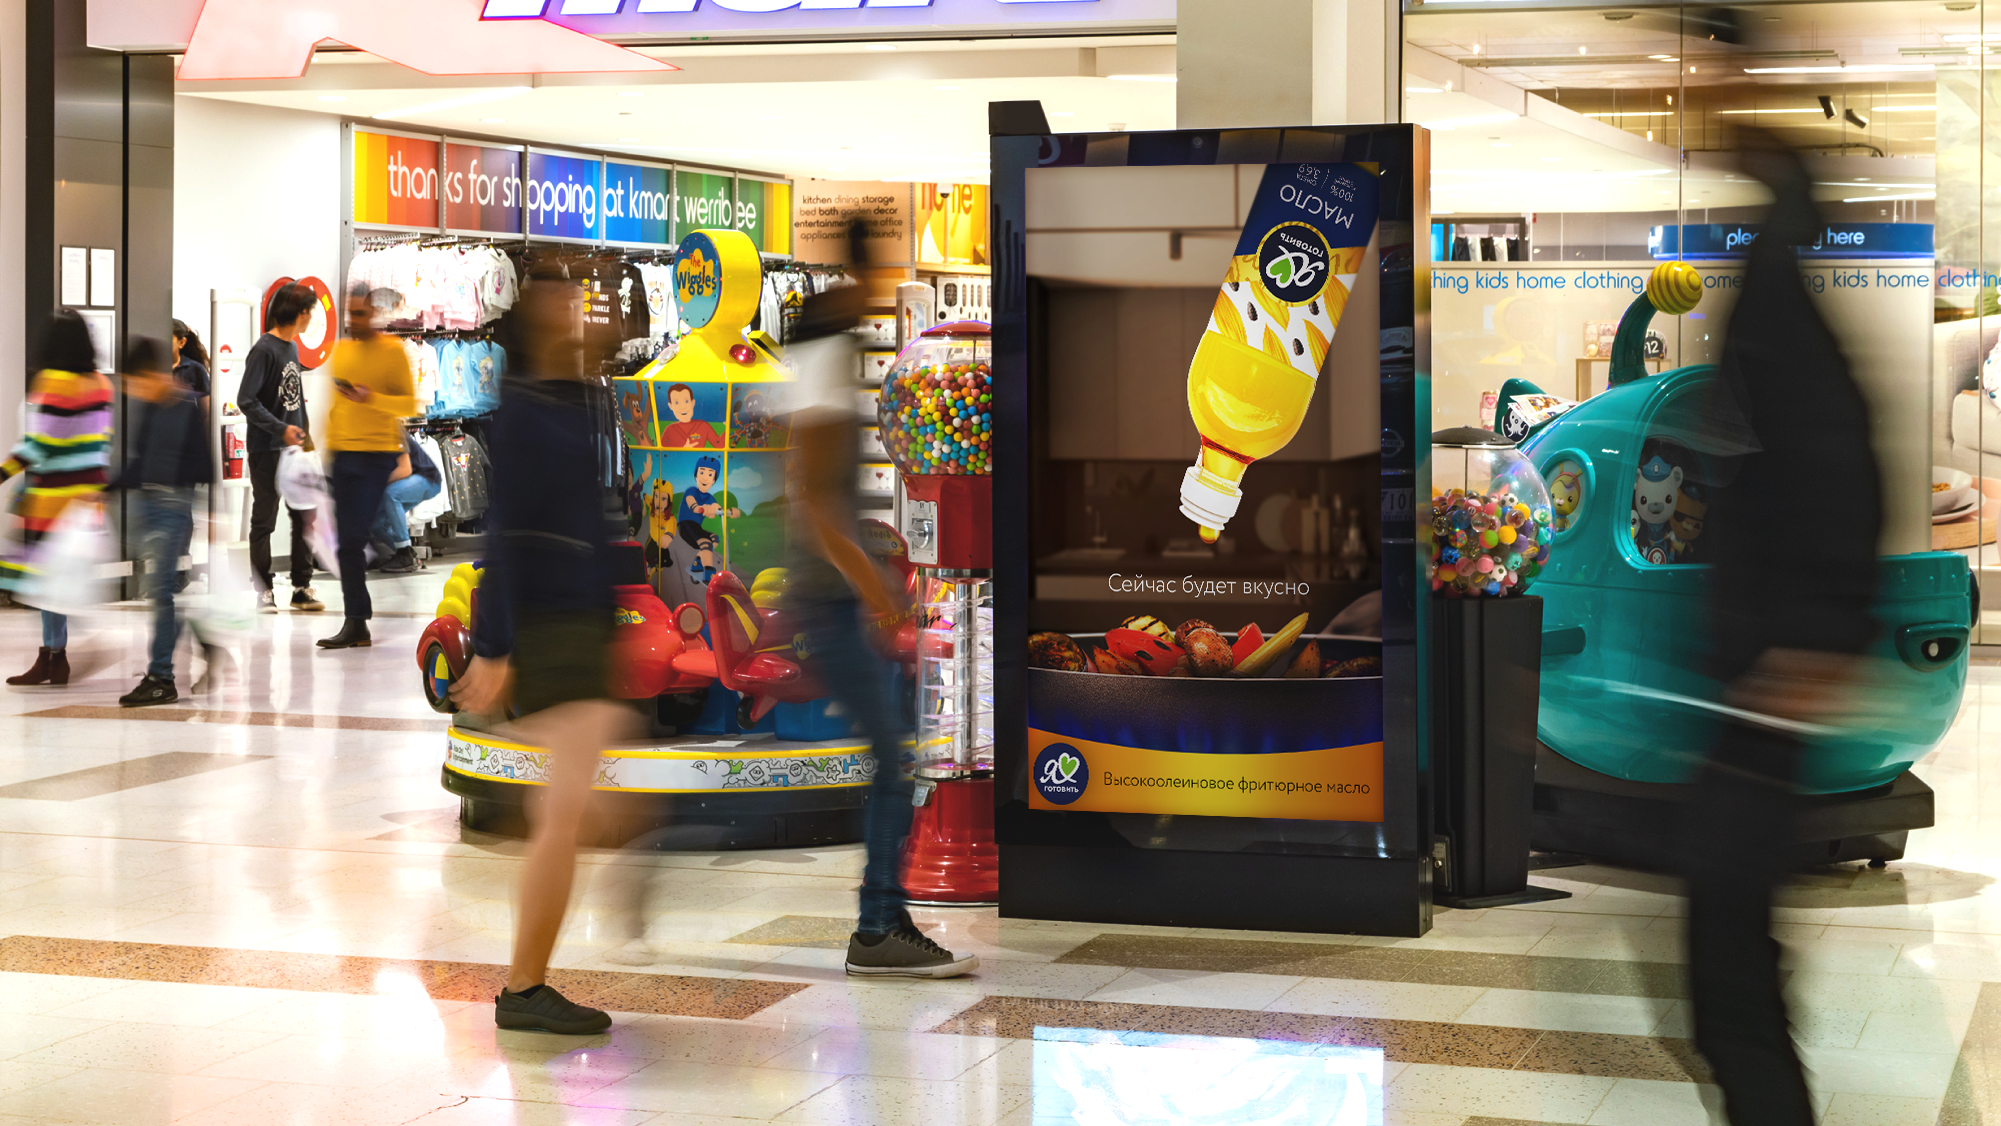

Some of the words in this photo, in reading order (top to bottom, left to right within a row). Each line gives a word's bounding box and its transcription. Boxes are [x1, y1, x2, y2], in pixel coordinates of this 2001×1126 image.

[388, 150, 463, 204] thanks
[468, 159, 498, 206] for
[503, 163, 596, 229] shopping
[604, 180, 624, 218] at
[629, 177, 680, 223] kmart
[684, 186, 757, 230] werribee
[1330, 185, 1354, 203] 100%
[802, 195, 833, 205] kitchen
[834, 196, 860, 207] dining
[861, 195, 895, 206] storage
[1280, 184, 1355, 230] МАСЛО
[799, 207, 816, 216] bed
[818, 206, 839, 216] bath
[840, 206, 871, 219] garden
[873, 206, 898, 215] decor
[794, 218, 851, 228] entertainment
[879, 218, 903, 227] office
[800, 230, 846, 242] appliances
[870, 229, 902, 241] laundry
[1827, 227, 1865, 245] here
[689, 253, 701, 268] The
[675, 265, 717, 296] Wiggles
[1430, 270, 1469, 295] hing
[1475, 270, 1509, 289] kids
[1516, 270, 1567, 289] home
[1574, 270, 1644, 295] clothing
[1701, 275, 1744, 289] ome
[1832, 268, 1869, 288] kids
[1876, 268, 1930, 288] home
[1938, 268, 2001, 289] clothin
[1108, 573, 1177, 593] Сейчас
[1182, 574, 1237, 599] будет
[1243, 580, 1310, 600] вкусно
[1103, 771, 1235, 791] Высокоолеиновое
[1237, 776, 1323, 797] фритюрное
[1326, 782, 1371, 795] масло
